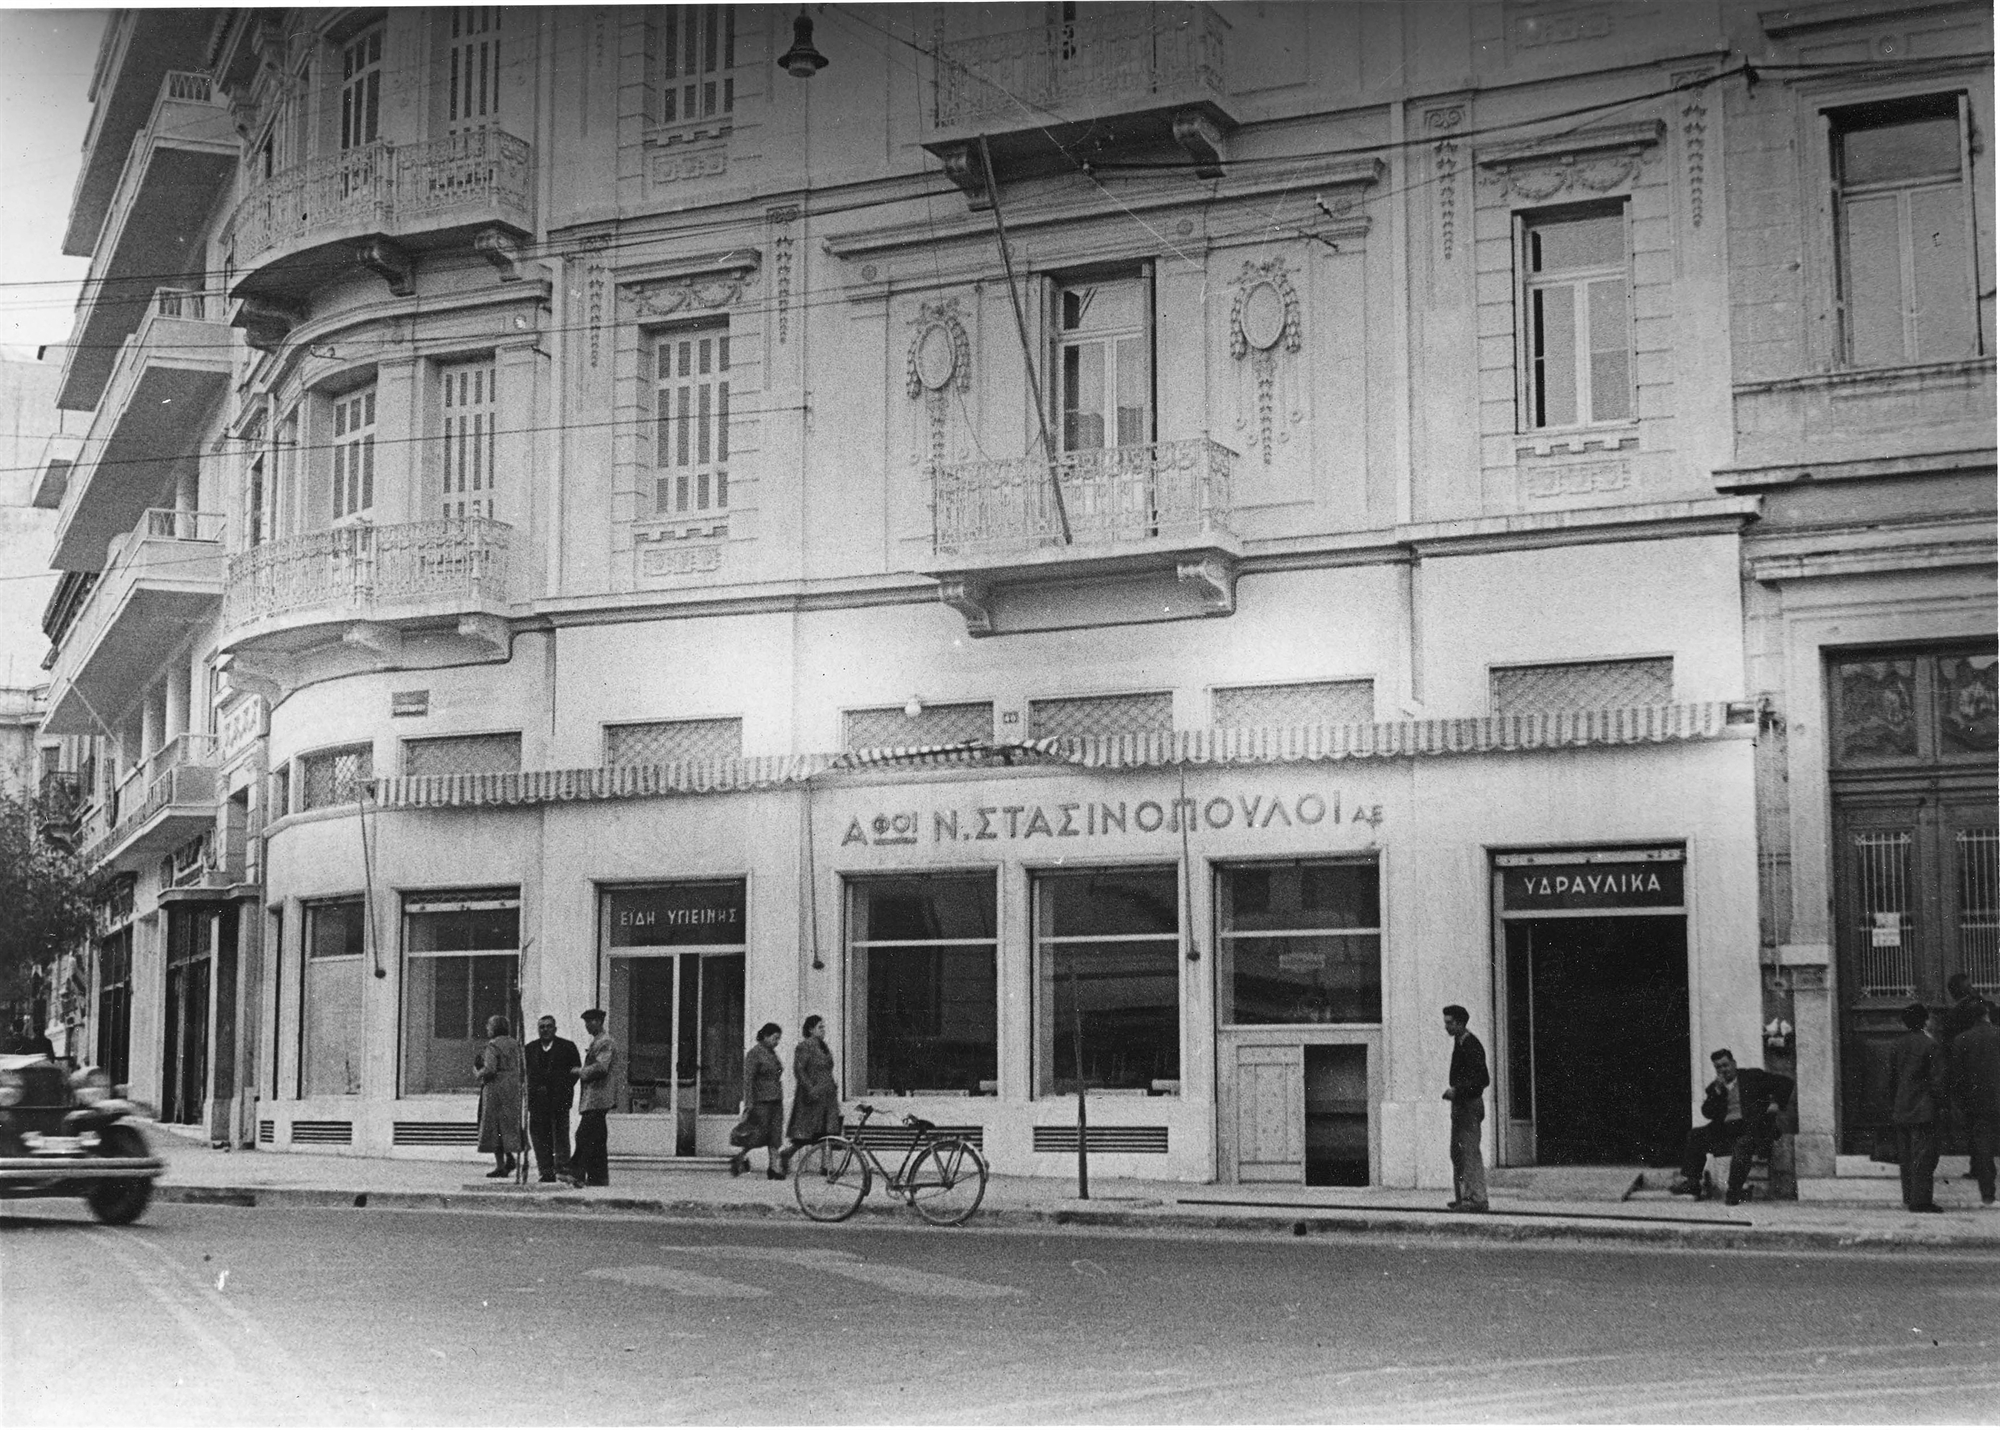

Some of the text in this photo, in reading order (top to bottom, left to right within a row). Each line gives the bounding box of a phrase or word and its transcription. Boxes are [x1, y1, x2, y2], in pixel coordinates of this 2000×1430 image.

[1524, 873, 1661, 895] ΥΔΡΑΥΛΙΚΑ
[620, 908, 737, 926] ΕΙΔΗ ΥΓΙΕΙΝΗΣ
